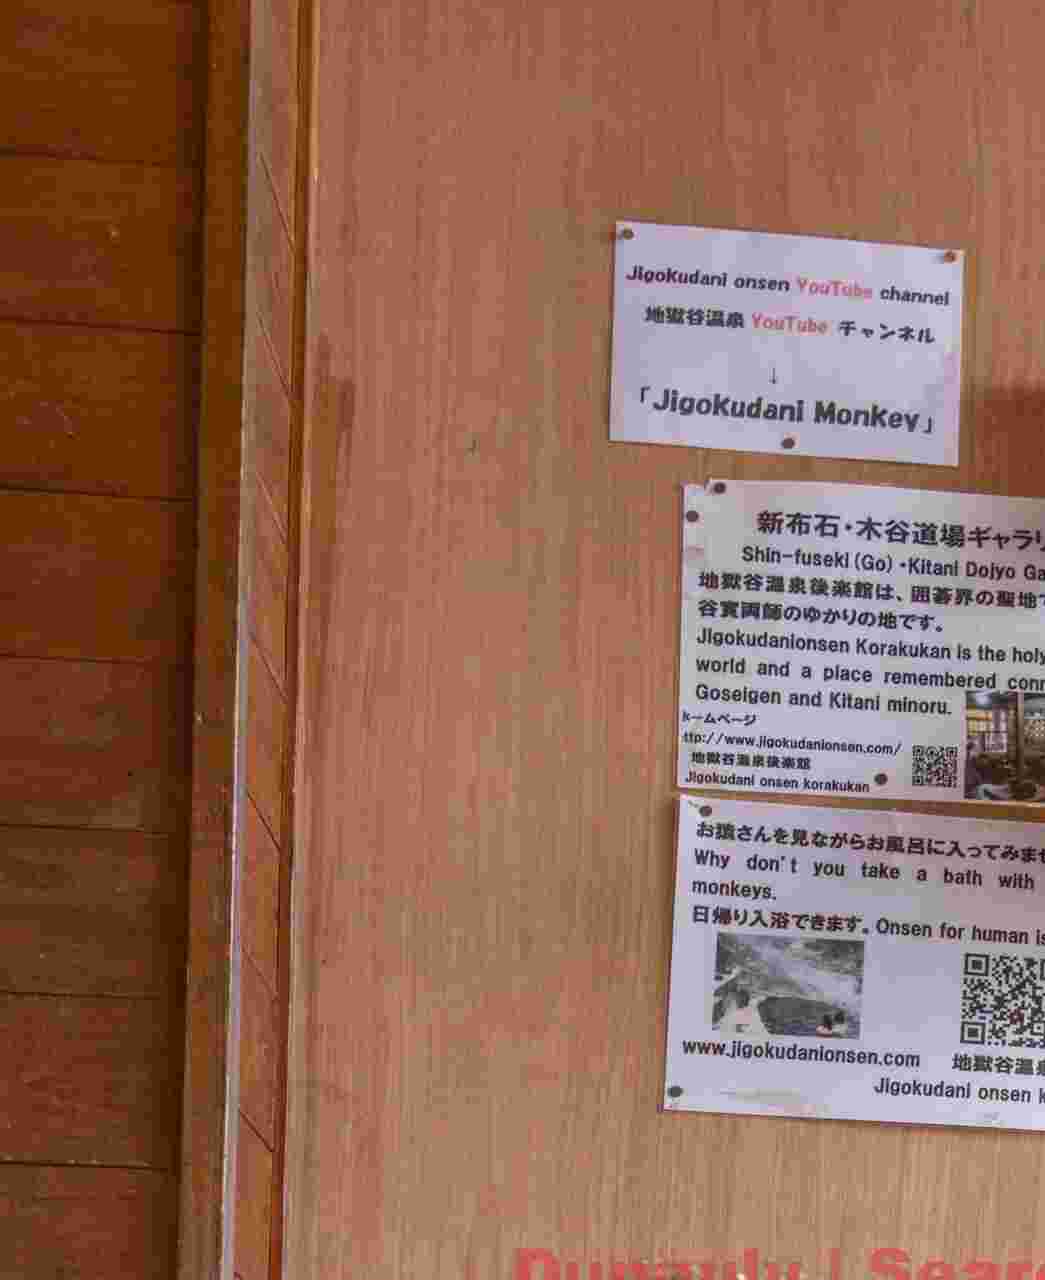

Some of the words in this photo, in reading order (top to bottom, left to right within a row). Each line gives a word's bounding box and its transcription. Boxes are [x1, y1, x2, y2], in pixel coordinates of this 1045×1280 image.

[625, 265, 727, 287] Jigokudani
[733, 276, 790, 292] onsen
[796, 277, 873, 299] YouTube
[880, 286, 949, 306] channel
[645, 306, 744, 329] 地獄谷温泉
[751, 312, 828, 334] YouTube
[839, 320, 935, 344] チャンネル
[966, 561, 1016, 581] Dojyo
[697, 628, 849, 653] Jigokudanionsen
[855, 638, 950, 660] Korakukan
[957, 645, 971, 661] is
[978, 646, 1006, 662] the
[696, 658, 745, 674] world
[757, 661, 790, 678] and
[801, 666, 812, 679] a
[823, 665, 872, 683] place
[884, 671, 996, 689] remembered
[696, 685, 781, 705] Goseigen
[789, 692, 822, 708] and
[829, 692, 880, 711] Kitani
[887, 696, 952, 715] minoru.
[686, 772, 755, 786] Jigokudani
[760, 776, 799, 789] onsen
[803, 779, 870, 793] korakukan
[695, 849, 730, 869] Why
[813, 861, 844, 877] you
[861, 862, 900, 880] take
[917, 869, 927, 882] a
[944, 868, 983, 887] bath
[1000, 873, 1034, 890] with
[692, 880, 777, 900] monkeys.
[876, 918, 932, 937] Onsen
[940, 922, 964, 939] for
[971, 925, 1028, 944] human
[682, 1040, 920, 1068] www.jigokudanionsen.com
[873, 1078, 971, 1100] Jigokudani
[978, 1086, 1031, 1104] onsen
